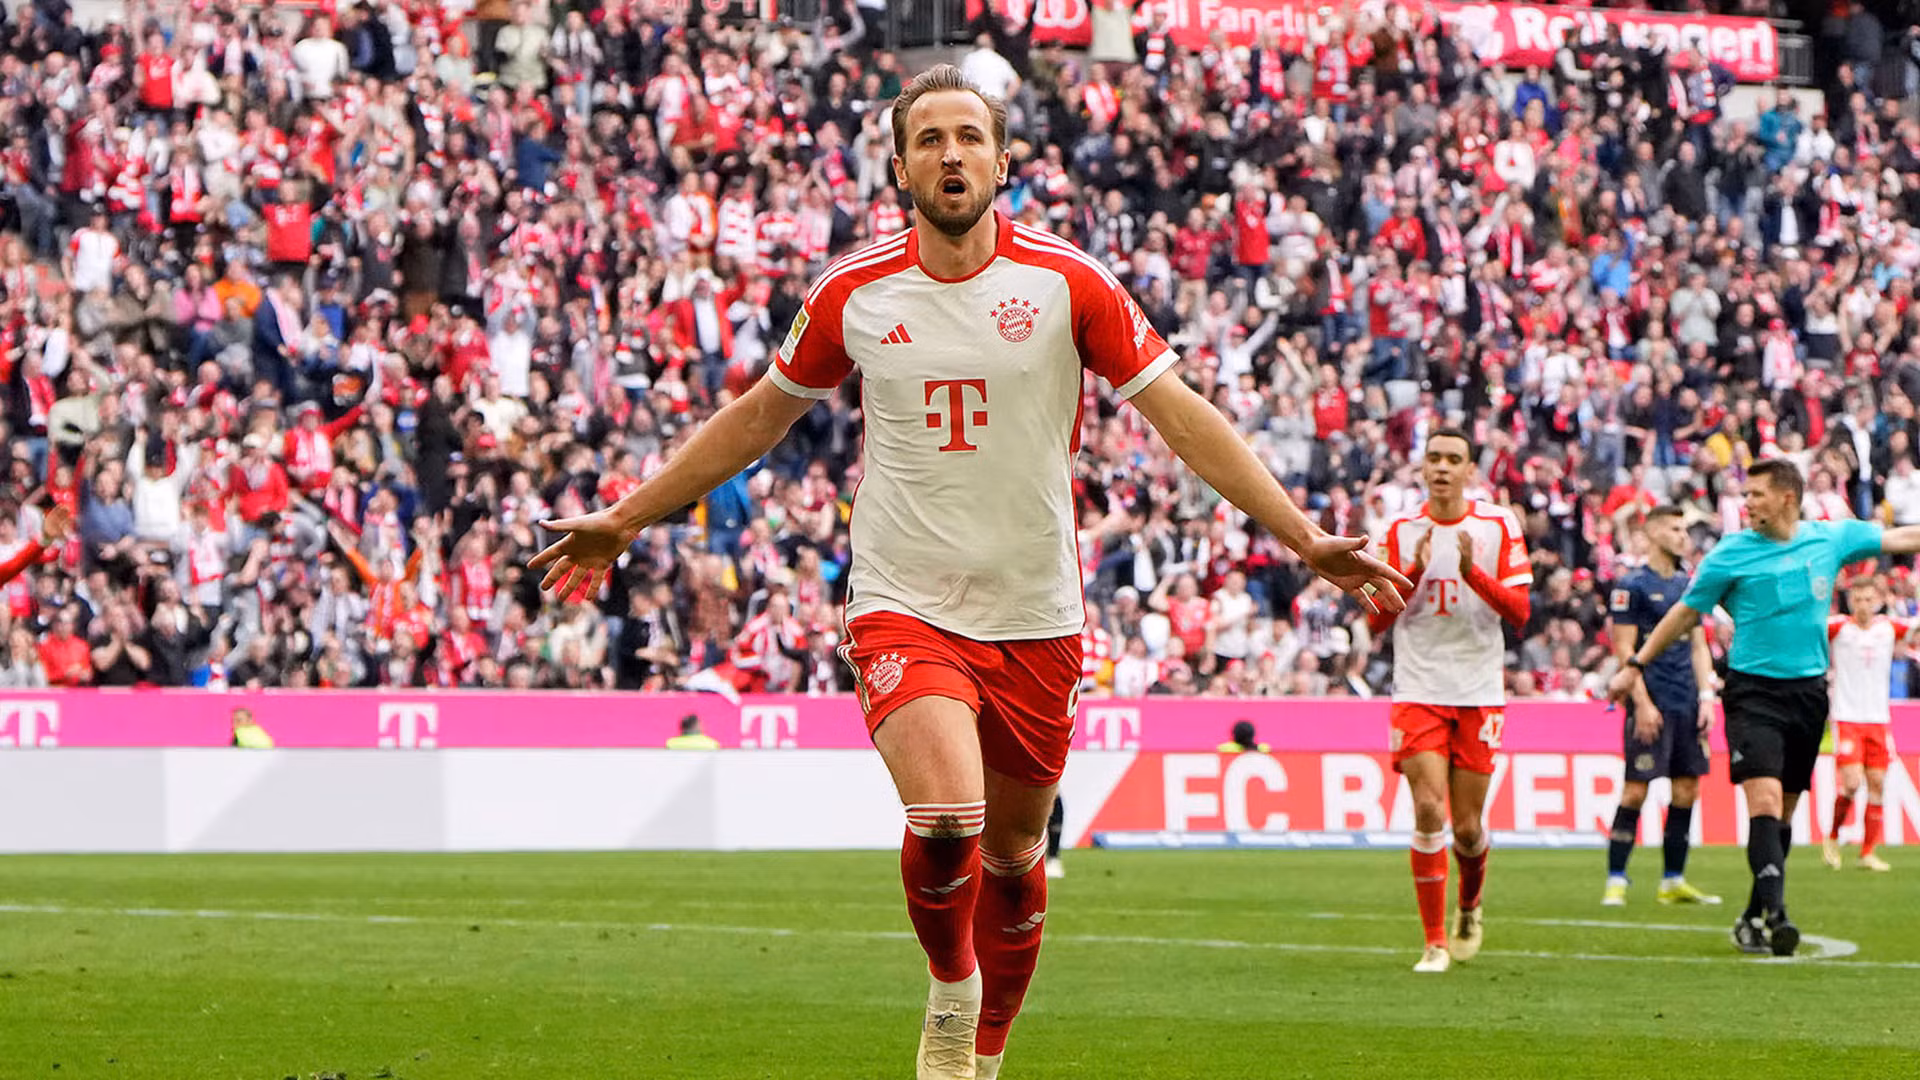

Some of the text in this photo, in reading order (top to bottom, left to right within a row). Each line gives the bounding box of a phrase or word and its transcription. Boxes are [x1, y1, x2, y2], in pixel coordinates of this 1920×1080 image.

[1112, 0, 1324, 37] udi Fanclu
[924, 379, 988, 452] T
[379, 703, 438, 749] T
[741, 705, 799, 750] T
[1086, 707, 1141, 751] T
[1162, 752, 1290, 832] FC
